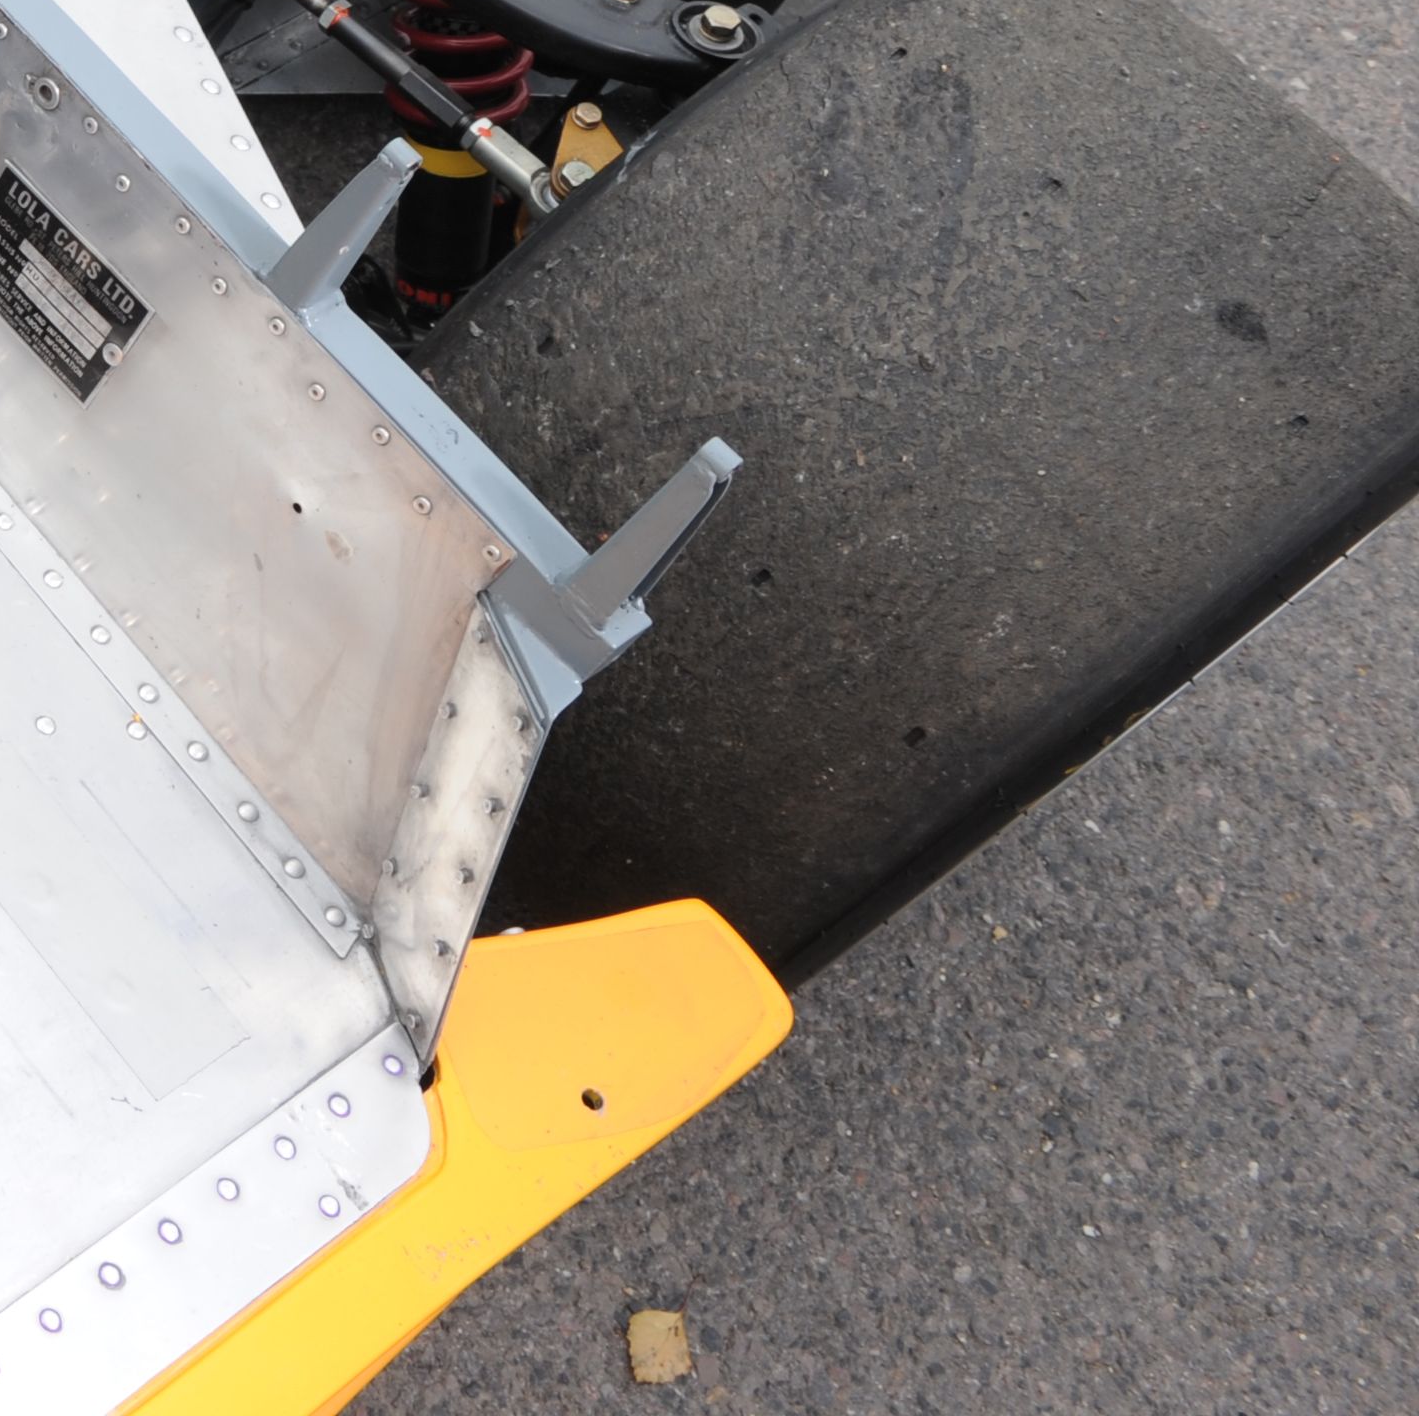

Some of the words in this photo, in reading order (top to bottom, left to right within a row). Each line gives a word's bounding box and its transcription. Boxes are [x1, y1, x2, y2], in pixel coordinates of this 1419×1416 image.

[6, 180, 53, 231] LOLA
[51, 225, 103, 282] CARS
[101, 276, 140, 320] LTD.
[10, 286, 33, 313] SERVICE
[32, 309, 47, 327] AND
[45, 324, 87, 369] INFORMATION
[12, 300, 25, 316] THE
[24, 313, 43, 336] ABOVE
[43, 333, 83, 379] INFORMATION
